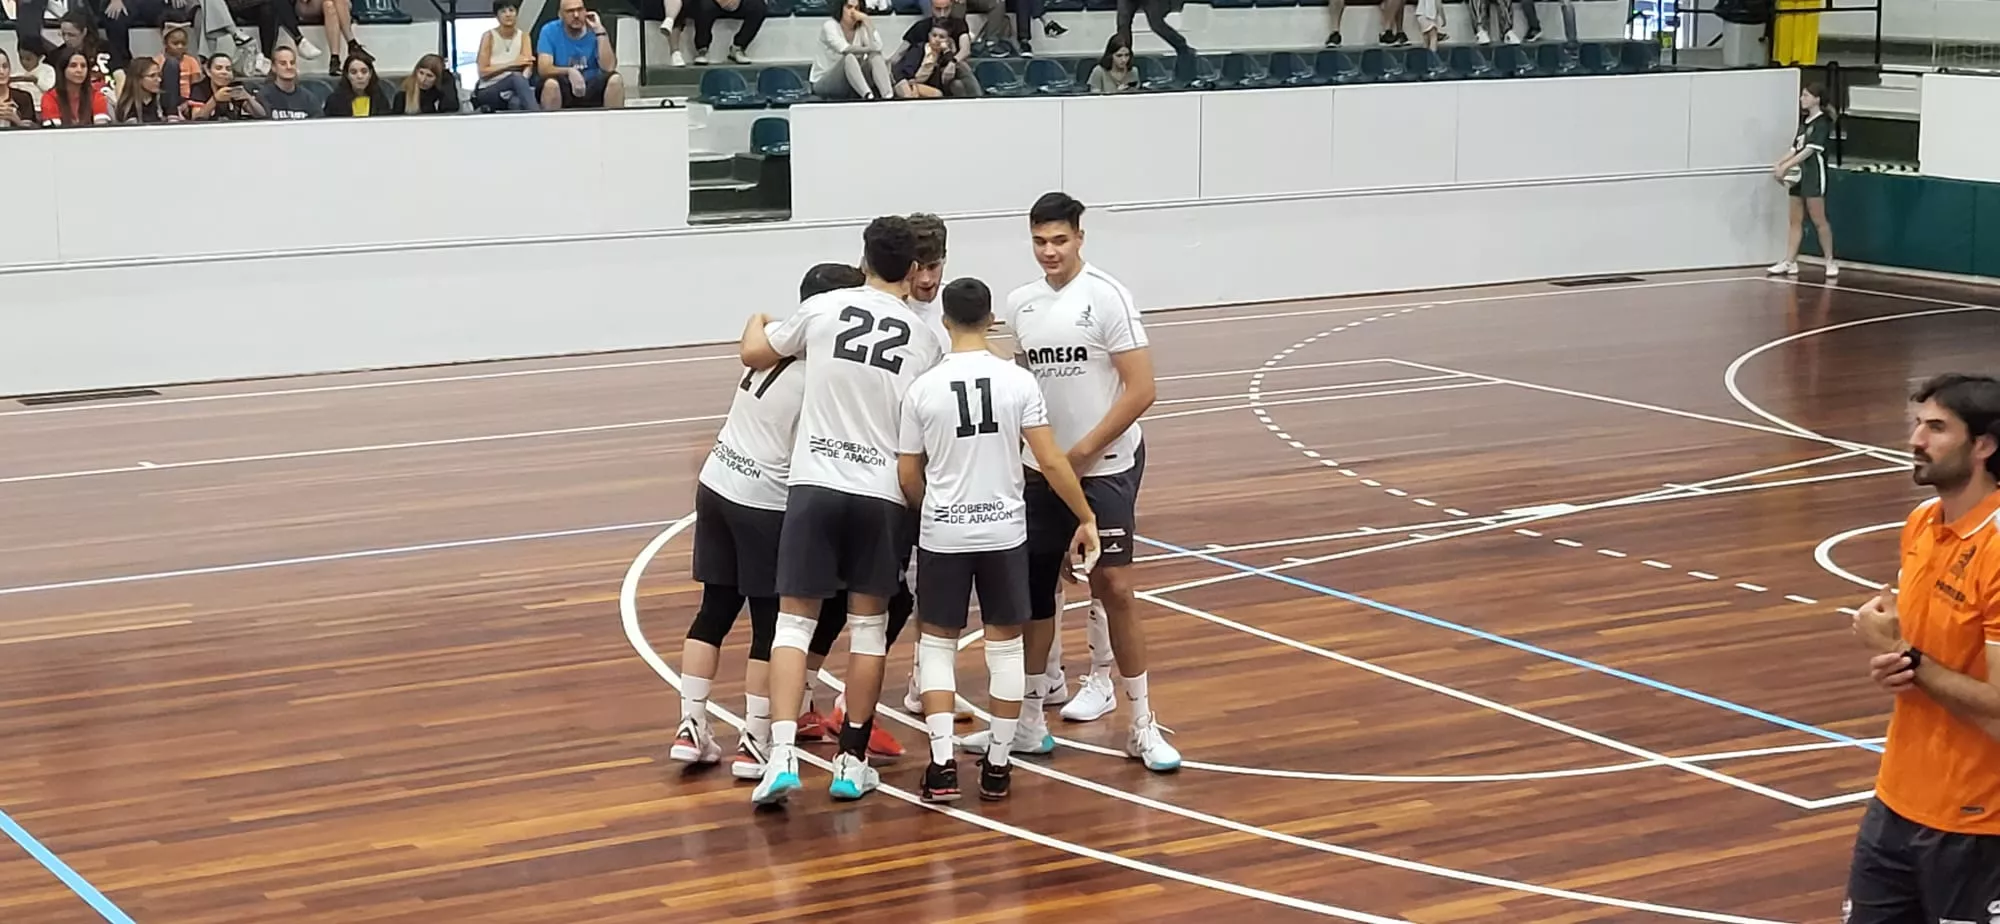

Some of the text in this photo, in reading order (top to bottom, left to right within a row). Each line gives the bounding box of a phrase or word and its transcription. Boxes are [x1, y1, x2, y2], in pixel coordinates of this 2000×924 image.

[833, 306, 911, 375] 22
[1028, 346, 1088, 365] AMESA
[950, 378, 998, 438] 11
[826, 438, 879, 457] GOBIERNO
[827, 448, 840, 459] DE
[950, 501, 1005, 514] GOBIERNO
[950, 515, 965, 524] DE
